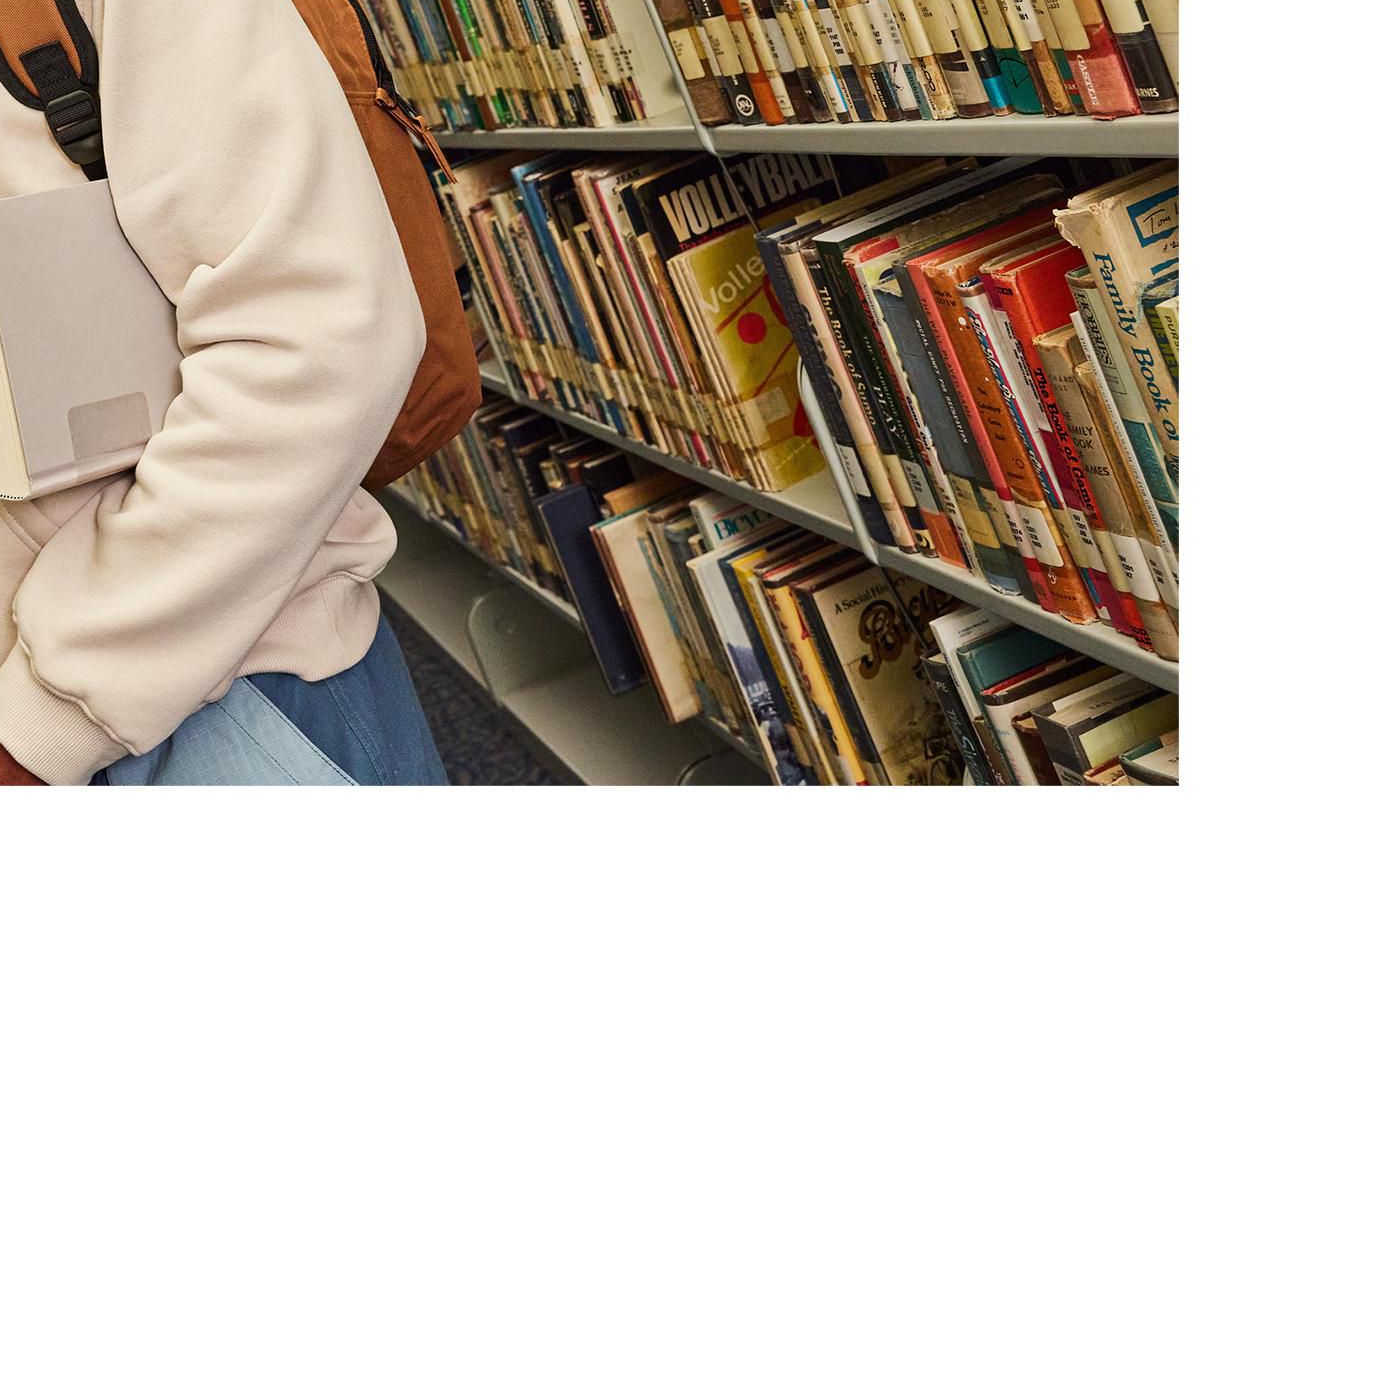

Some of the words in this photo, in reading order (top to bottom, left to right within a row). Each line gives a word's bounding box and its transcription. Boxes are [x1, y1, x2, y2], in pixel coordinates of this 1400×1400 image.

[615, 170, 640, 185] JEAN
[1142, 208, 1172, 233] Tom
[816, 285, 837, 316] The
[827, 316, 855, 360] Book
[1075, 290, 1114, 367] HOBBIES
[1089, 245, 1143, 342] Family
[1129, 338, 1173, 417] Book
[845, 360, 862, 381] of
[852, 378, 880, 426] Sumo
[870, 382, 902, 439] PLAY
[1031, 366, 1053, 399] The
[1044, 400, 1071, 443] Book
[1061, 444, 1078, 464] of
[1070, 425, 1094, 438] AMILY
